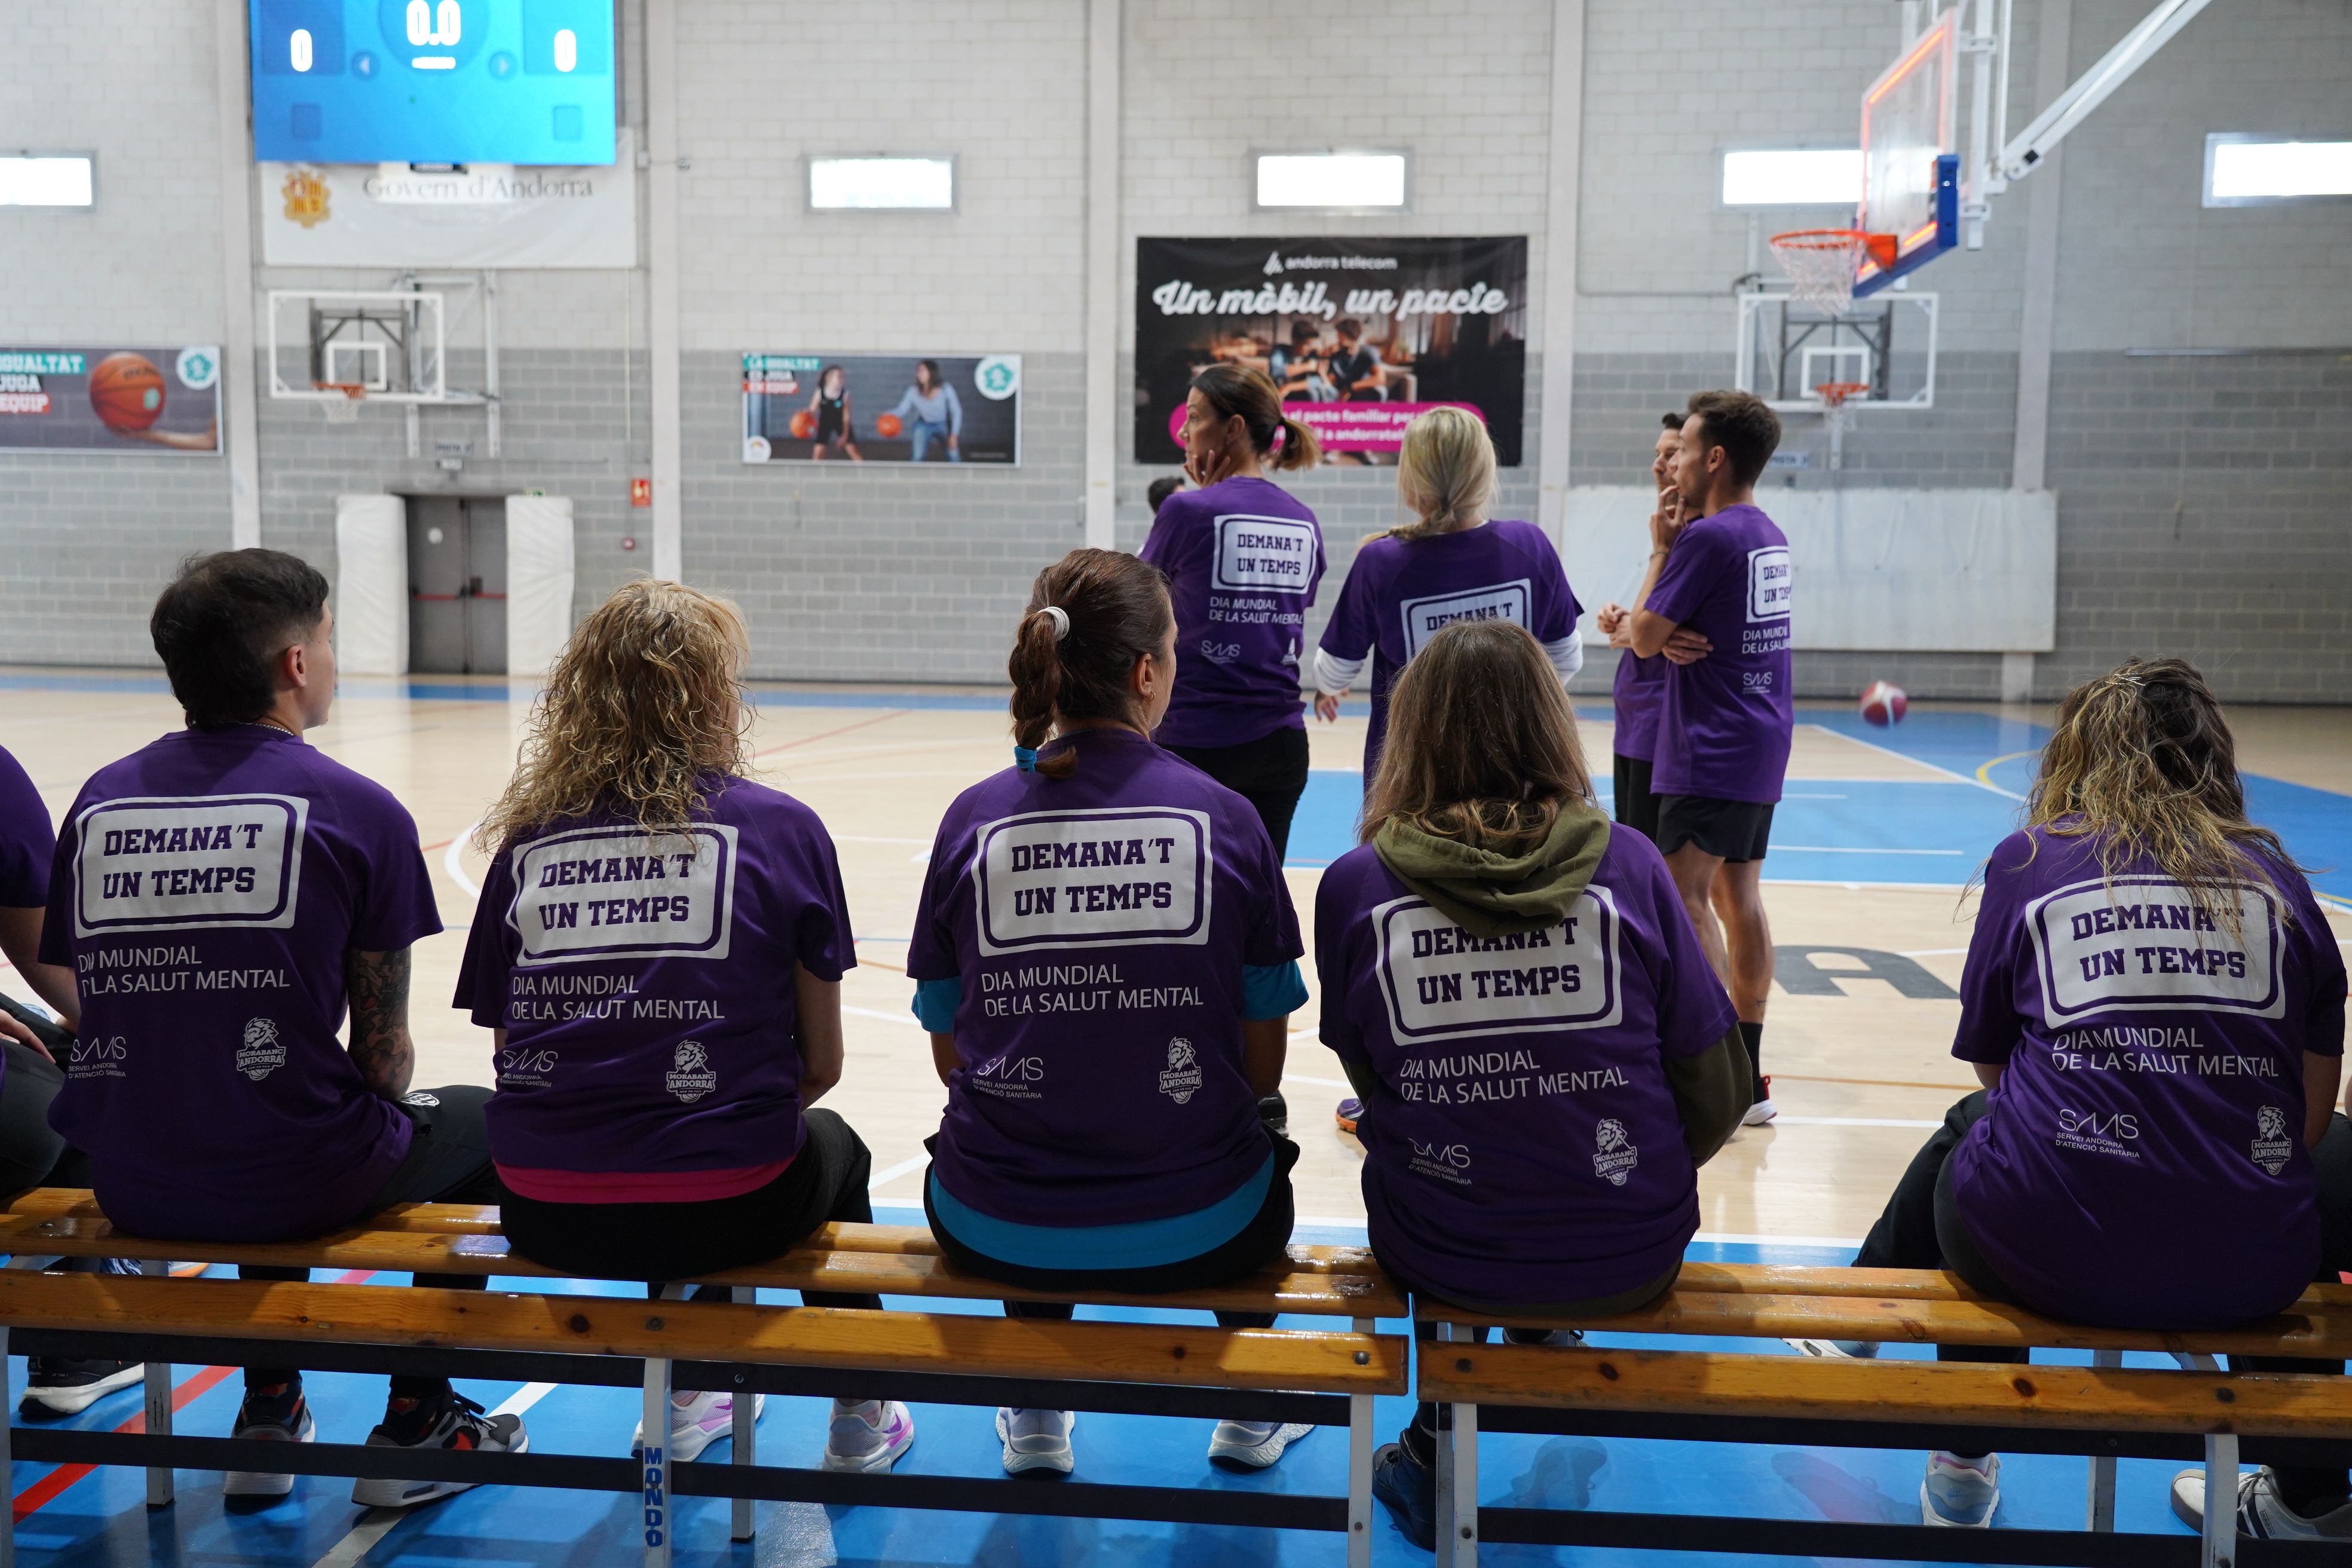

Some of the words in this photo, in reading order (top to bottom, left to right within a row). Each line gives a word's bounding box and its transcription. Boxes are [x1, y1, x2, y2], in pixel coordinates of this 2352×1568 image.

[291, 29, 313, 72] 0
[555, 29, 577, 72] 0
[362, 176, 458, 199] Govern
[467, 174, 593, 199] d'Andorra
[1285, 256, 1339, 270] andorra
[1342, 255, 1397, 270] telecom
[1153, 279, 1217, 316] Un
[1215, 281, 1337, 321] mòbil,
[1344, 287, 1398, 315] un
[1394, 281, 1508, 322] pacte
[0, 354, 82, 373] GUALTAT
[1238, 534, 1303, 552] DEMANA'T
[1238, 558, 1256, 572] UN
[1260, 559, 1301, 575] TEMPS
[1210, 596, 1230, 610] DIA
[1233, 598, 1278, 611] MUNDIAL
[1764, 587, 1777, 603] UN
[1209, 609, 1223, 622] DE
[1225, 610, 1239, 623] LA
[1241, 611, 1270, 624] SALUT
[1742, 629, 1762, 641] DIA
[1742, 642, 1756, 654] DE
[1758, 641, 1769, 653] LA
[103, 823, 263, 856] DEMANA'T
[1012, 837, 1175, 872] DEMANA'T
[538, 853, 695, 889] DEMANA'T
[103, 871, 142, 899] UN
[151, 866, 256, 896] TEMPS
[1014, 887, 1056, 917] UN
[1066, 881, 1171, 913] TEMPS
[539, 902, 579, 930] UN
[588, 896, 690, 927] TEMPS
[1411, 917, 1578, 958] DEMANAT
[99, 945, 202, 969] MUNDIAL
[2080, 949, 2126, 982] UN
[2135, 946, 2246, 979] TEMPS
[90, 975, 118, 995] LA
[121, 971, 190, 993] SALUT
[195, 969, 290, 990] MENTAL
[513, 976, 537, 996] DIA
[541, 974, 639, 996] MUNDIAL
[981, 970, 1015, 993] DIA
[1019, 963, 1124, 989] MUNDIAL
[1417, 973, 1462, 1005] UN
[1471, 964, 1581, 1000] TEMPS
[512, 1001, 531, 1020] DE
[534, 1001, 556, 1020] LA
[562, 999, 627, 1021] SALUT
[632, 999, 725, 1019] MENTAL
[984, 997, 1009, 1017] DE
[1013, 996, 1034, 1015] LA
[1039, 990, 1111, 1013] SALUT
[1117, 987, 1203, 1009] MENTAL
[2053, 1029, 2094, 1052] DIA
[2092, 1027, 2204, 1048] MUNDIAL
[239, 1049, 284, 1058] MORABANC
[239, 1055, 283, 1068] ANDORRA
[1399, 1058, 1425, 1080] DIA
[1429, 1049, 1541, 1078] MUNDIAL
[2051, 1053, 2082, 1071] DE
[2090, 1052, 2121, 1071] LA
[2124, 1052, 2191, 1075] SALUT
[2198, 1054, 2279, 1077] MENTAL
[669, 1079, 713, 1089] ANDORRA
[972, 1077, 993, 1088] SERVEI
[1162, 1068, 1200, 1080] MORABANC
[1162, 1075, 1200, 1089] ANDORRA
[1401, 1082, 1424, 1102] DE
[1428, 1082, 1451, 1104] LA
[1455, 1076, 1531, 1104] SALUT
[1538, 1065, 1630, 1097] MENTAL
[2056, 1132, 2084, 1143] SERVEI
[2056, 1139, 2097, 1152] D'ATENCIÓ
[2099, 1146, 2140, 1158] SANITÀRIA
[1411, 1157, 1432, 1167] SERVEI
[1595, 1149, 1635, 1163] MORABANC
[2254, 1147, 2290, 1159] ANDORRA
[1598, 1155, 1635, 1174] ANDORRA
[644, 1447, 663, 1547] MONDO
[2261, 1512, 2274, 1534] adidas
